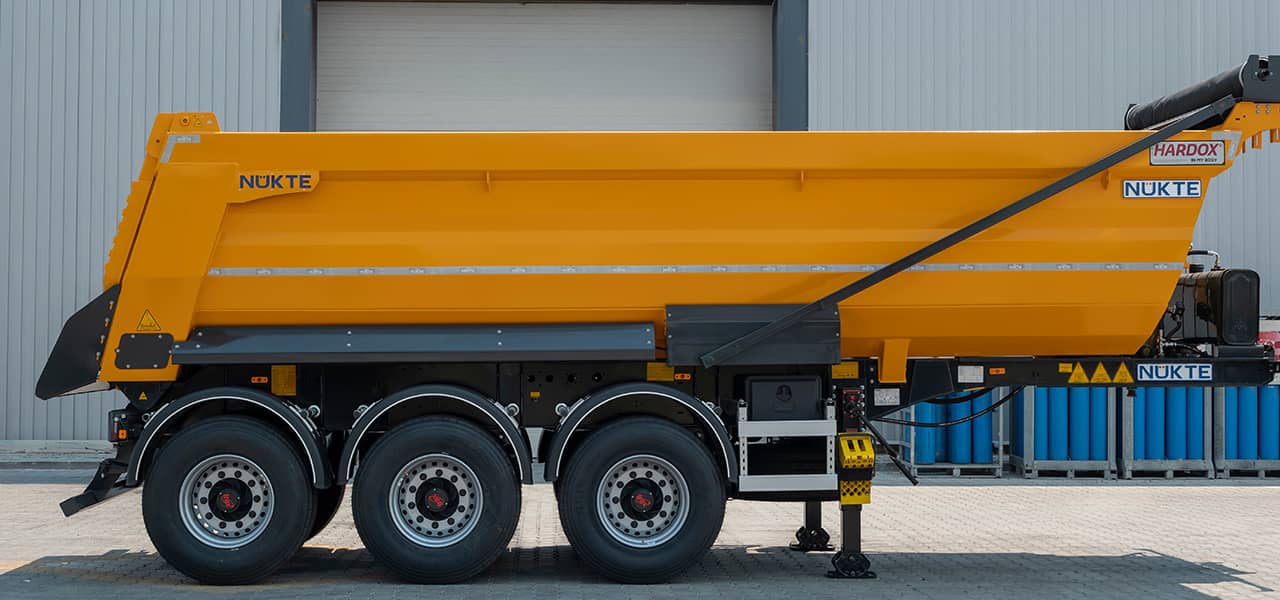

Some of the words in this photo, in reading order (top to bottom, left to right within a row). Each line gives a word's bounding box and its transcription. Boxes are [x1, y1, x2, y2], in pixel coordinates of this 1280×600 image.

[239, 174, 312, 189] NÜKTE
[1125, 181, 1200, 196] NÜKTE
[1139, 365, 1211, 379] NÜKTE
